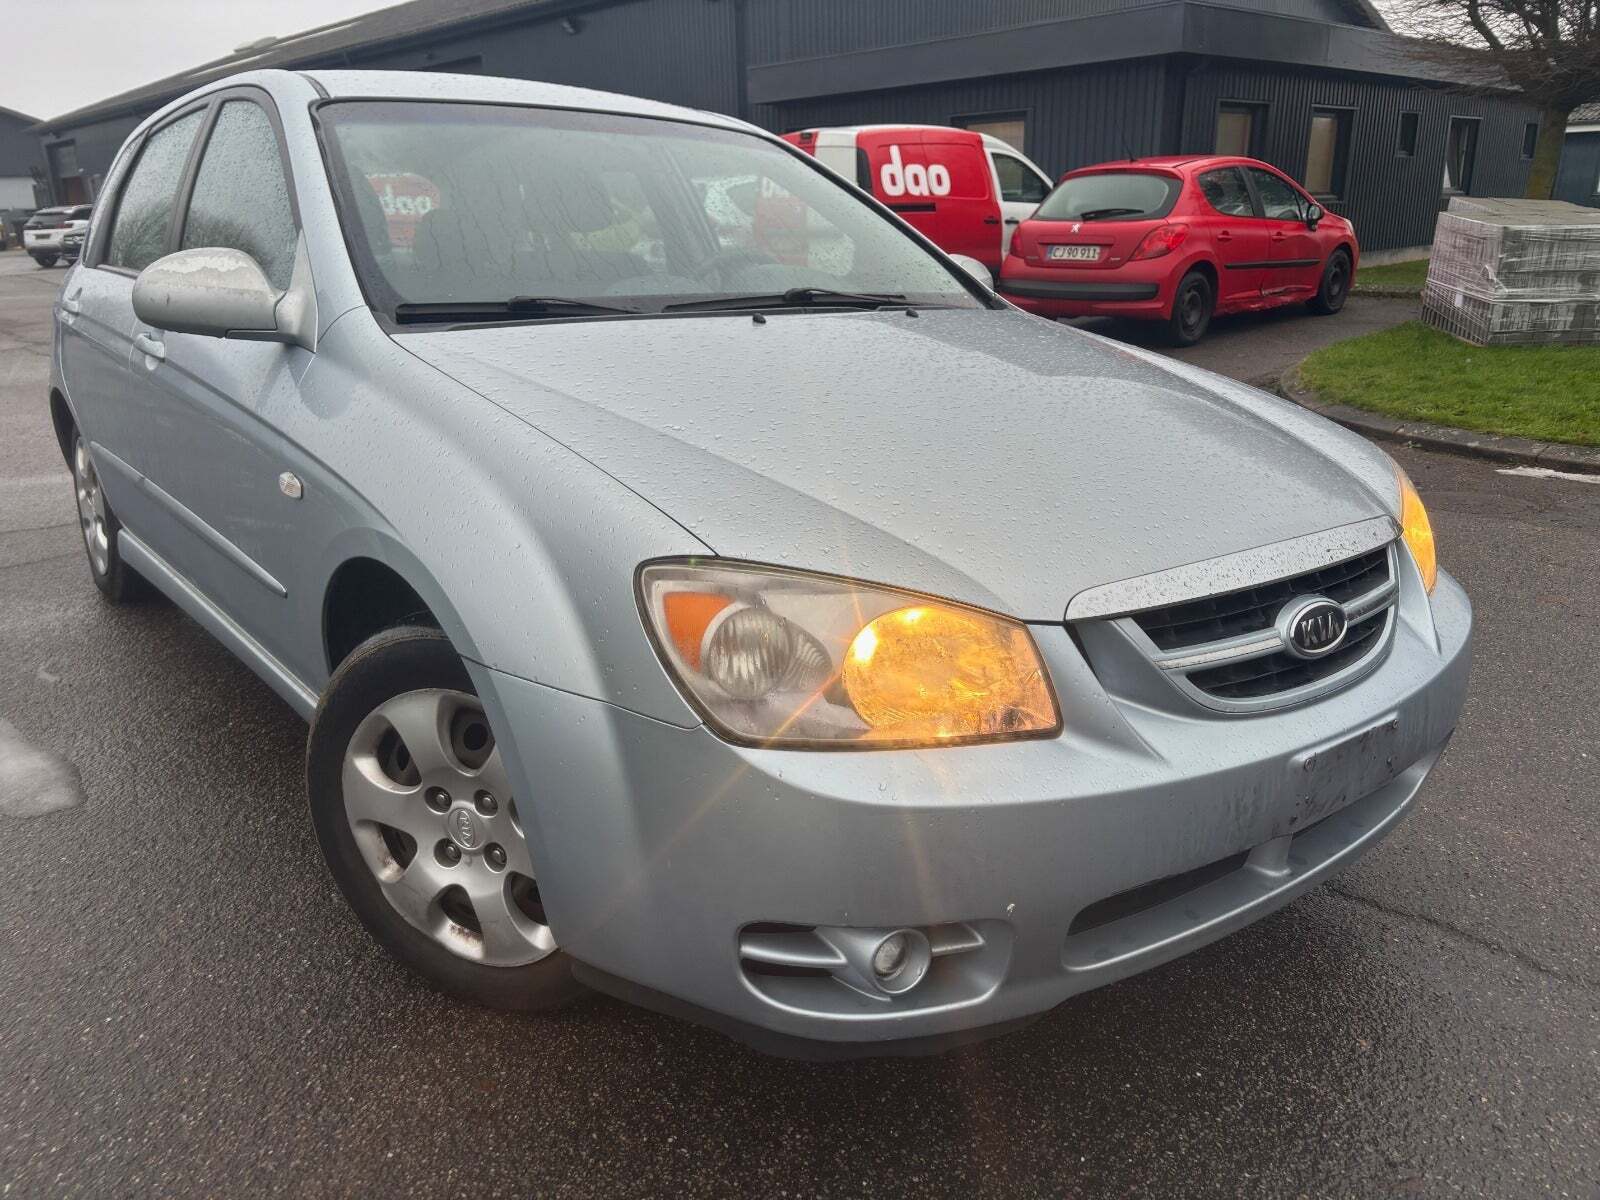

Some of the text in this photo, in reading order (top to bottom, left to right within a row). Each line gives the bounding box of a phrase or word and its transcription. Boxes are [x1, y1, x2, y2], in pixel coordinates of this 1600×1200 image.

[880, 144, 951, 196] dao
[1080, 247, 1097, 258] 911
[1300, 611, 1341, 647] KIA
